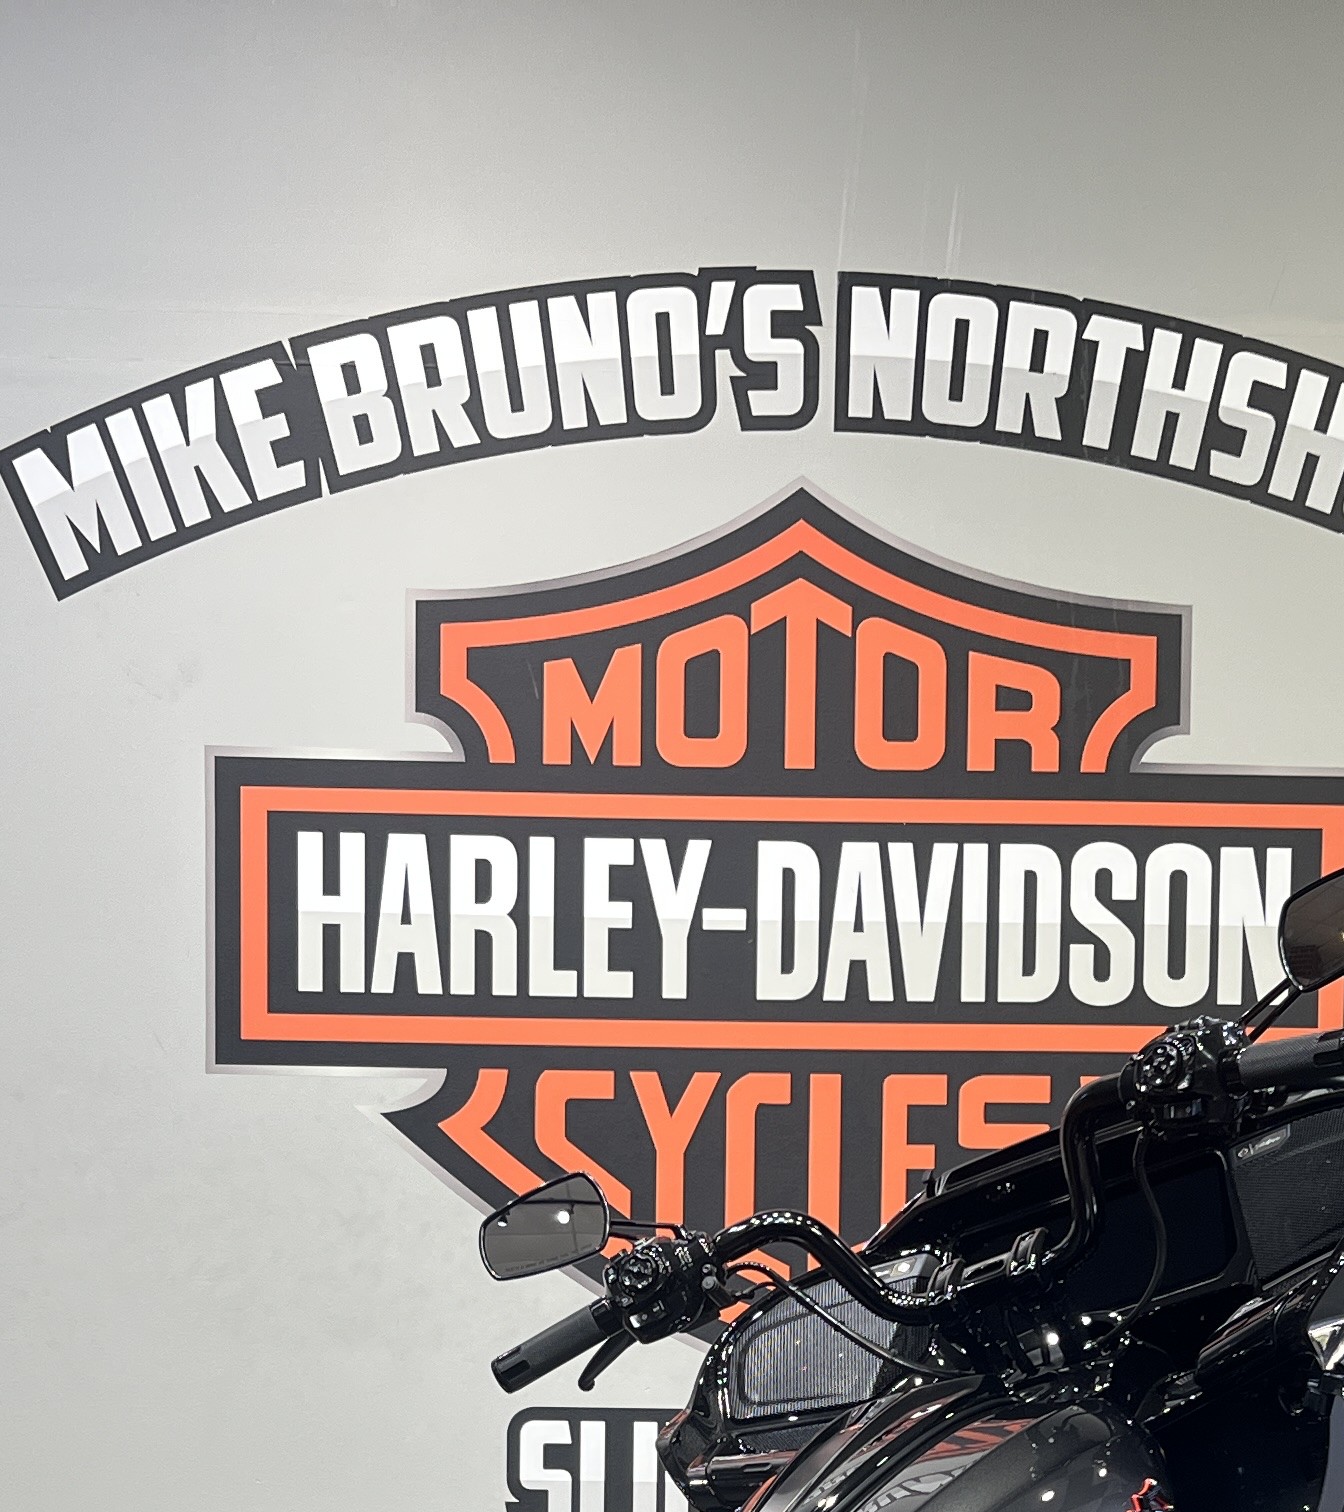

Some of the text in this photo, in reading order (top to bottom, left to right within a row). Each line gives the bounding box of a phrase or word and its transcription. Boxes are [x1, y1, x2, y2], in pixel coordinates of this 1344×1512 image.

[11, 358, 307, 582] MIKE
[307, 281, 805, 477] BRUNO'S
[541, 577, 1061, 773] MOTOR
[297, 829, 1293, 1007] HARLEY-DAVIDSON
